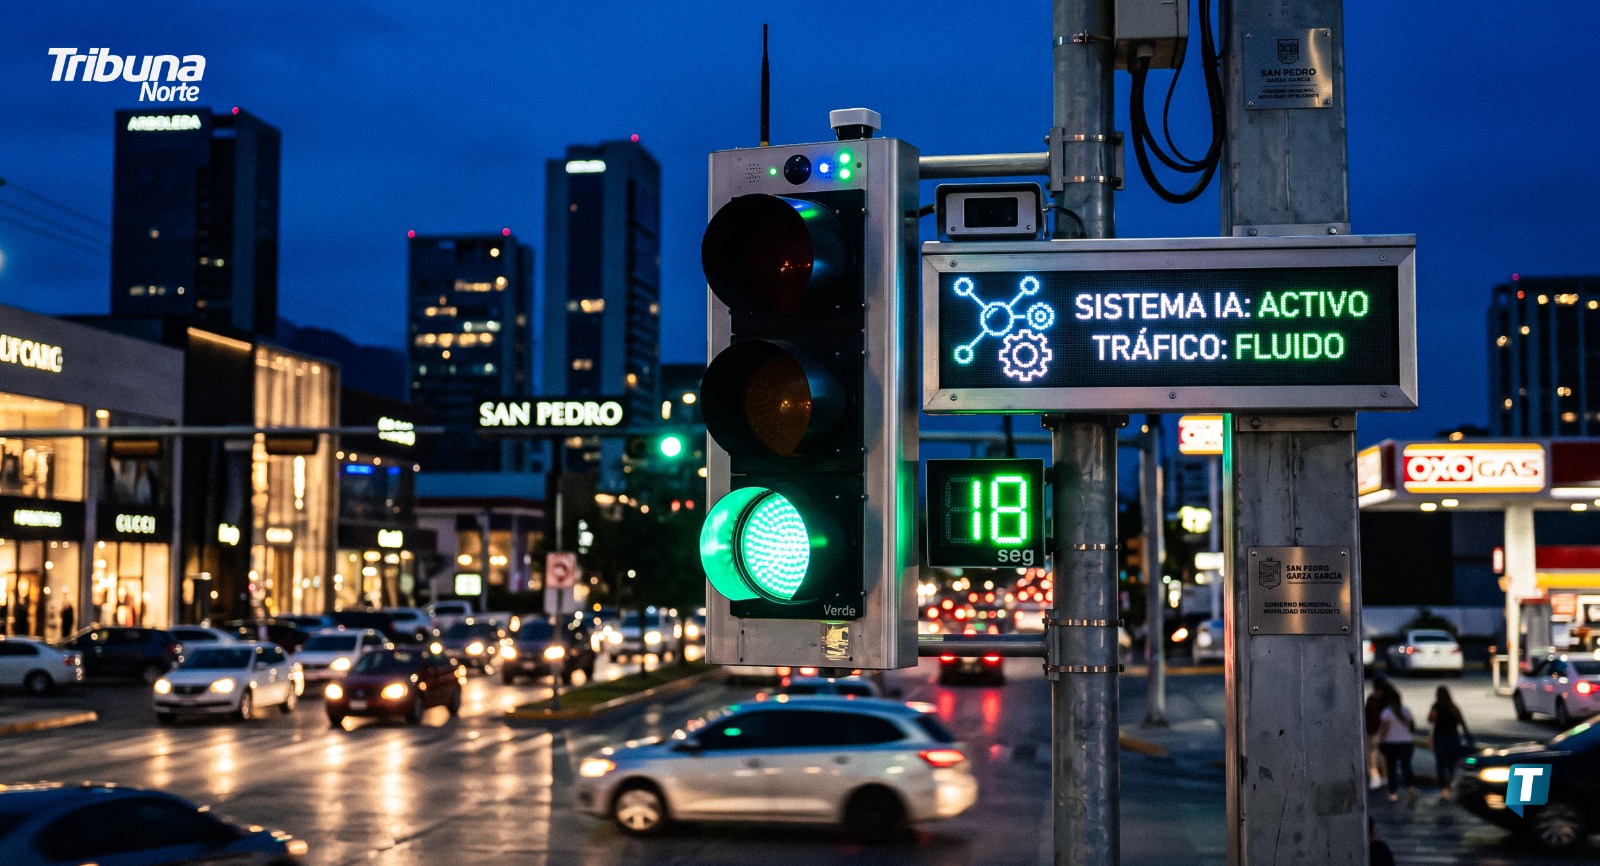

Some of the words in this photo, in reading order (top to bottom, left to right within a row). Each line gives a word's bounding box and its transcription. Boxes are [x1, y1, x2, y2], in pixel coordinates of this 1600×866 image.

[1284, 68, 1316, 76] PEDRO
[1075, 293, 1207, 319] SISTEMA
[1215, 292, 1251, 318] IA:
[1258, 291, 1370, 318] ACTIVO
[1092, 327, 1228, 361] TRÁFICO:
[1235, 333, 1345, 360] FLUIDO
[479, 401, 531, 427] SAN
[536, 401, 623, 427] PEDRO
[1406, 455, 1473, 481] OXO
[1478, 459, 1539, 477] GAS
[973, 475, 1028, 545] 18
[997, 547, 1035, 566] seg
[1314, 571, 1342, 580] GARCÍA
[823, 604, 856, 616] Verde
